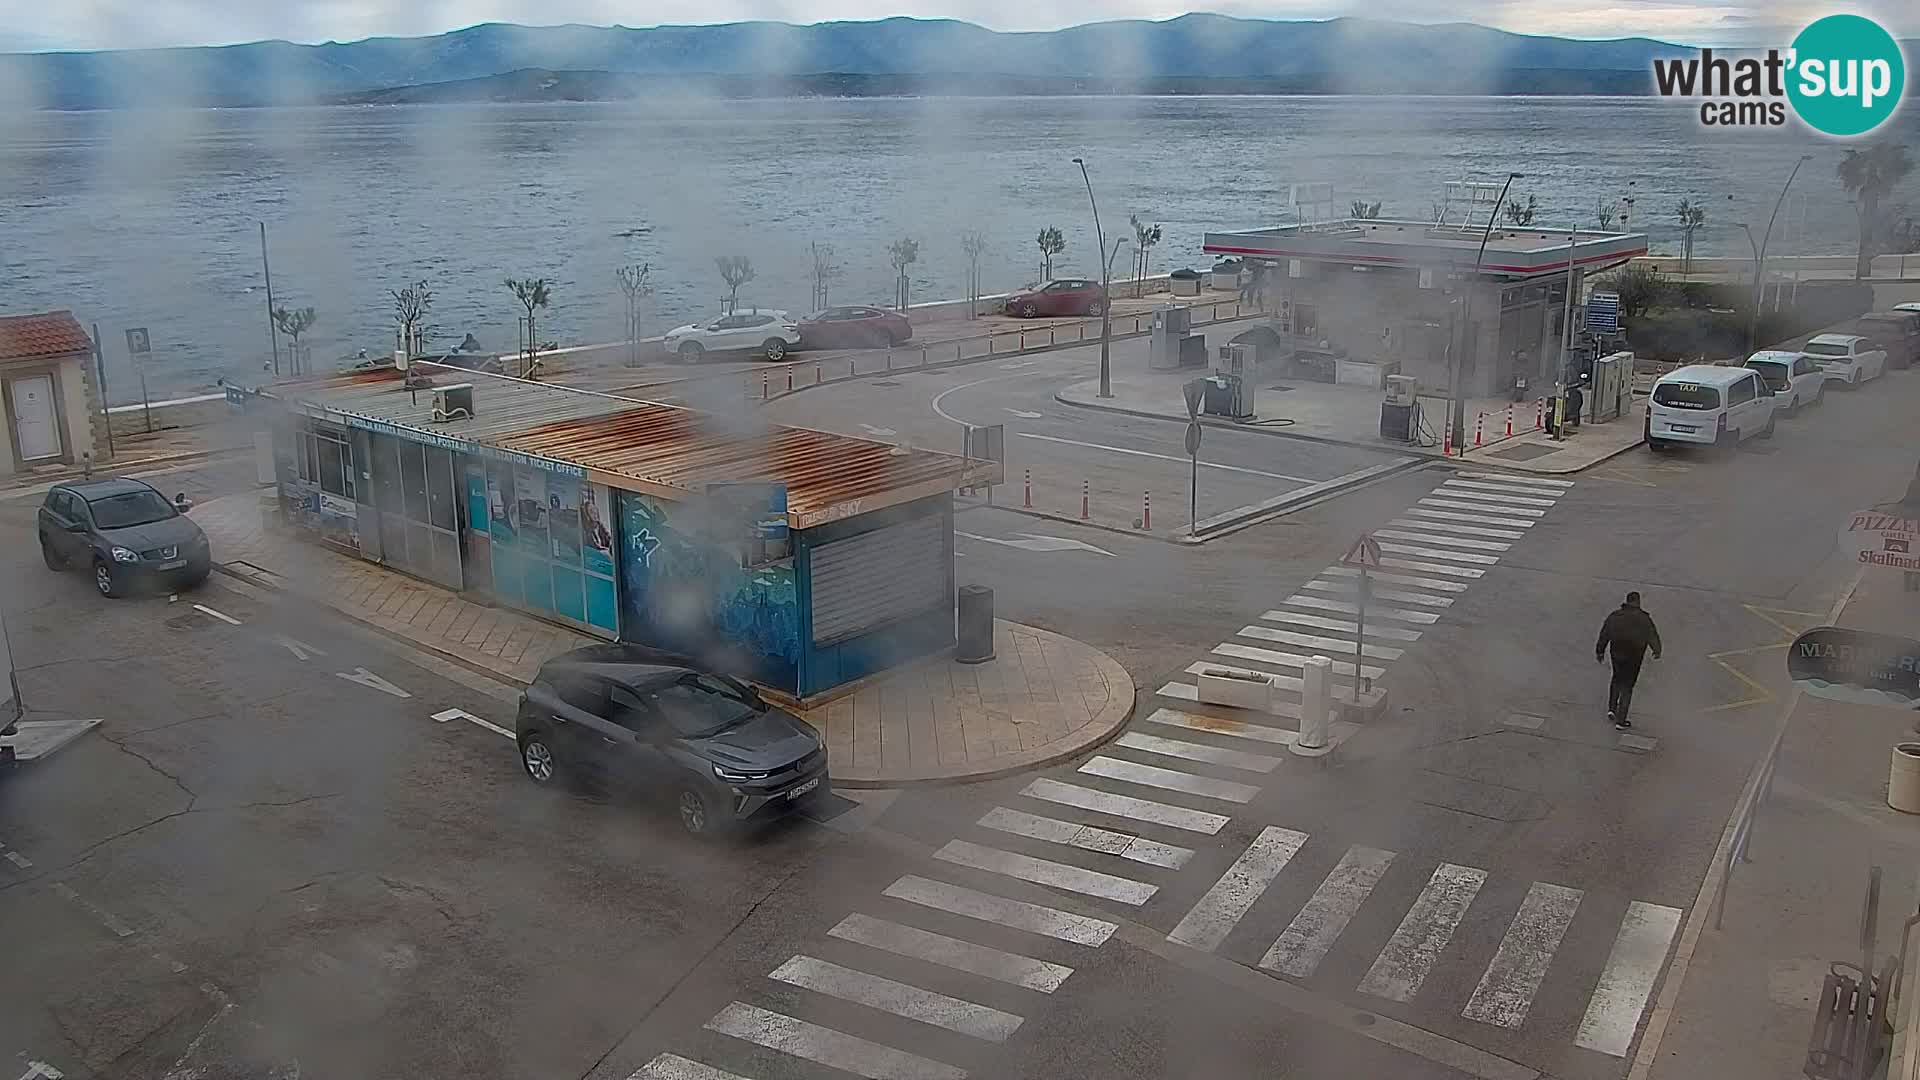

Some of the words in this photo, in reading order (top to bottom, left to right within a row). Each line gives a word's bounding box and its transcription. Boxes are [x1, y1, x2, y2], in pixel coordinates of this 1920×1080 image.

[1680, 383, 1697, 392] TAXI
[438, 437, 468, 451] POSTAJA
[529, 457, 556, 472] TICKET
[556, 464, 584, 478] OFFICE
[839, 500, 862, 518] SKY
